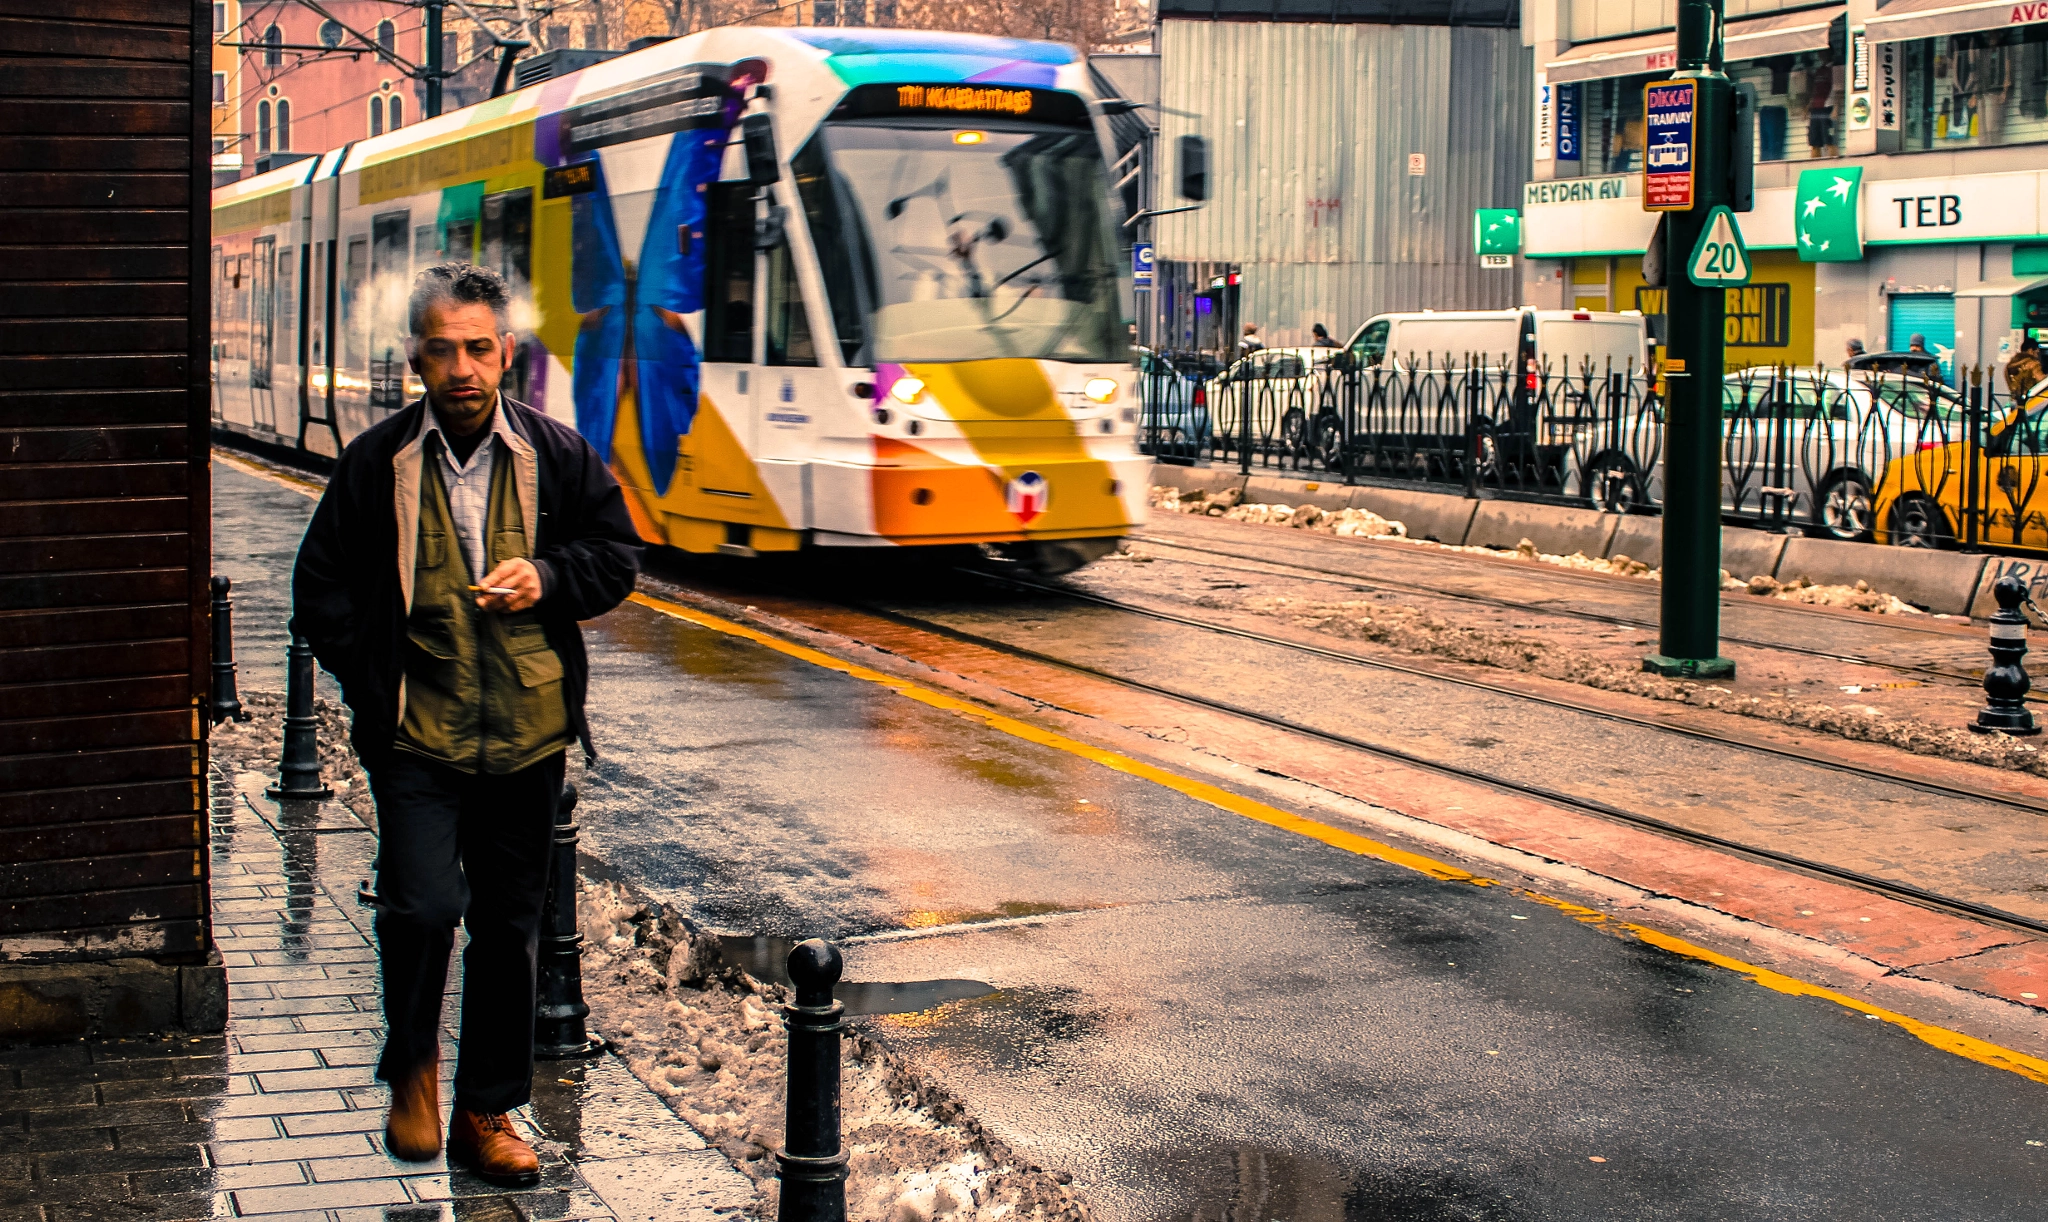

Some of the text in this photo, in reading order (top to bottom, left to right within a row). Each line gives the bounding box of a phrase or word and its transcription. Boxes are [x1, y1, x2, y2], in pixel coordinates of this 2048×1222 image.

[1649, 89, 1693, 108] DİKKAT
[1560, 84, 1573, 155] OPINE
[1648, 111, 1692, 126] TRAMVAY
[1528, 182, 1593, 203] MEYDAN
[1892, 194, 1962, 228] TEB
[1486, 255, 1508, 265] TEB
[1705, 242, 1737, 274] 20
